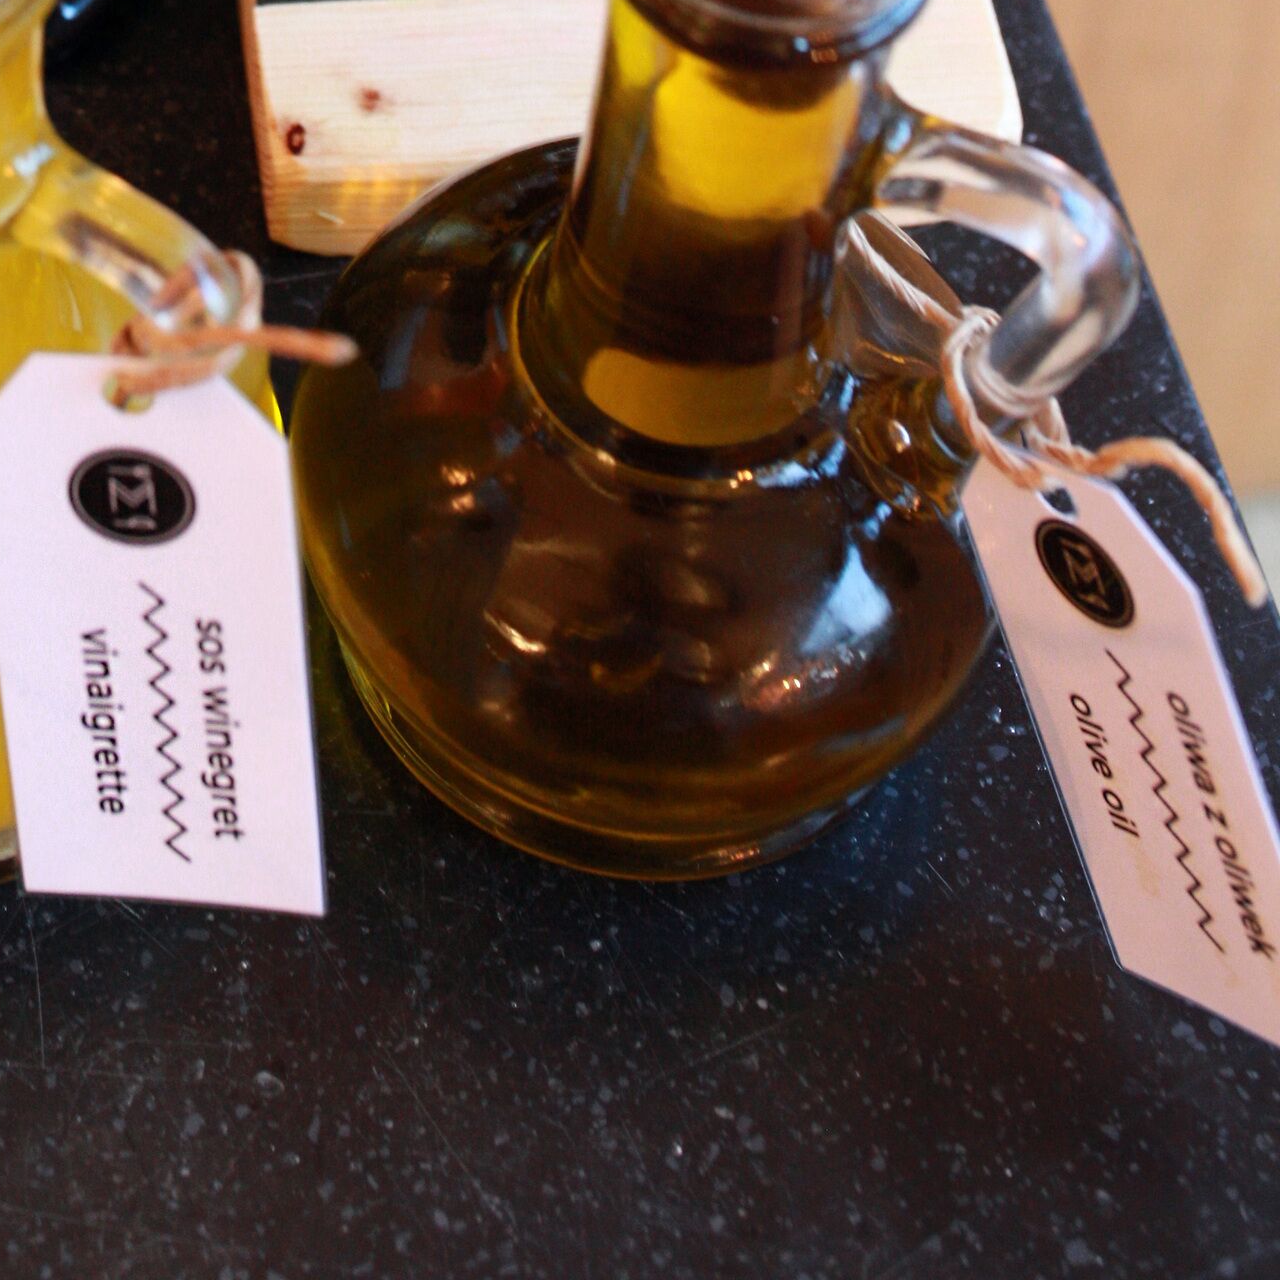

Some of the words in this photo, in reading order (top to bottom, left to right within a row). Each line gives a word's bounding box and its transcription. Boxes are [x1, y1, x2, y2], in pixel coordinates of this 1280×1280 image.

[196, 617, 226, 674] sos
[79, 626, 126, 817] vinaigrette
[200, 686, 246, 842] winegret
[1070, 692, 1113, 777] olive
[1102, 786, 1140, 840] oil
[1166, 691, 1218, 794] oliwa
[1201, 801, 1229, 830] z
[1214, 835, 1278, 962] oliwek
